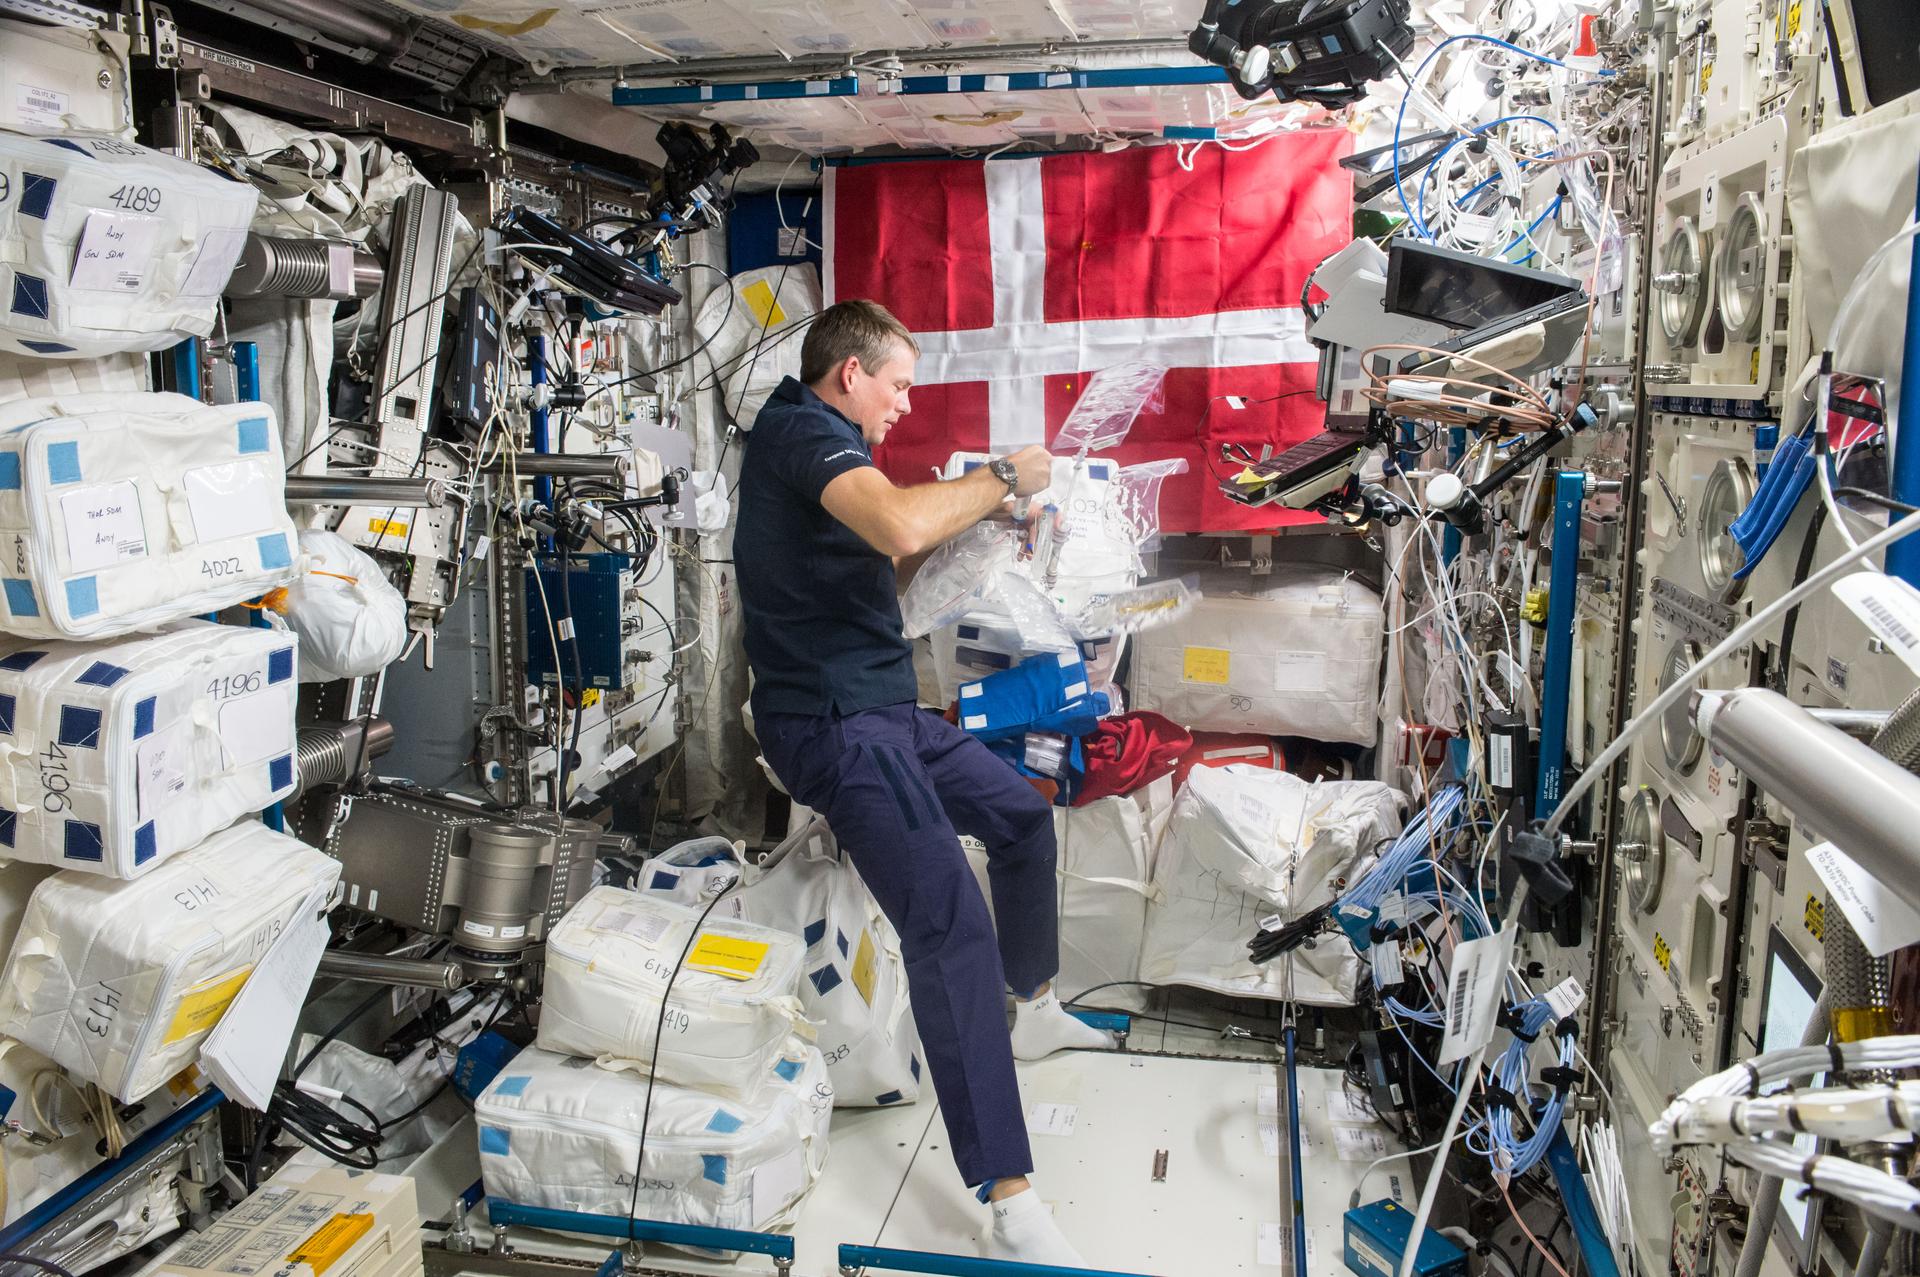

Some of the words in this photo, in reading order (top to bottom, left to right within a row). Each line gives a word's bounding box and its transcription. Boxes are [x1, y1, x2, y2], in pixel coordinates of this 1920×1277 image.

[202, 50, 216, 60] HRF
[216, 53, 238, 66] MARES
[238, 61, 252, 71] Rack
[109, 185, 161, 213] 4189
[14, 534, 26, 575] 4022
[201, 557, 244, 579] 4022
[206, 670, 262, 701] 4196
[39, 740, 73, 813] 4196
[1848, 886, 1863, 906] Power
[1860, 905, 1876, 923] Cable
[249, 919, 281, 958] 1413
[86, 980, 123, 1038] 1413
[664, 1009, 690, 1034] 419
